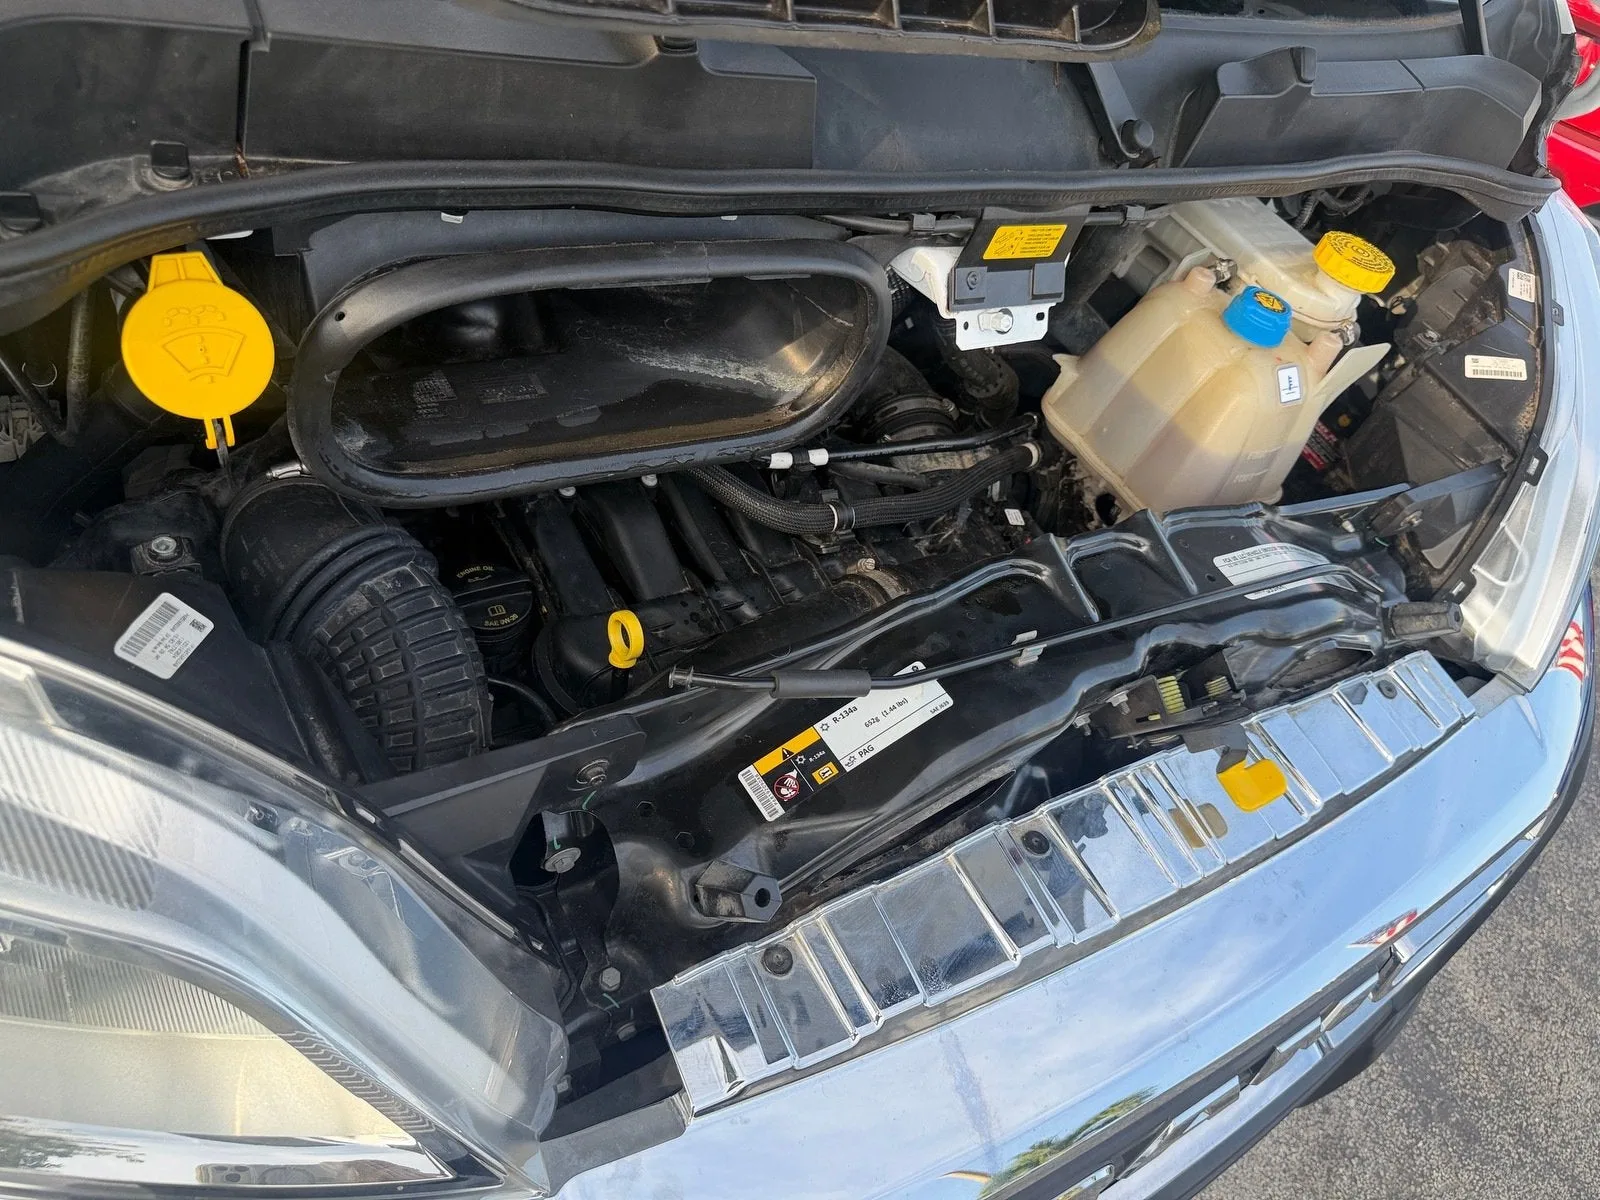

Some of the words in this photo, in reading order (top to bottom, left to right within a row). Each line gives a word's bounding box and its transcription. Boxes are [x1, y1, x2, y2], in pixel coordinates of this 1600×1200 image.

[456, 566, 481, 579] ENGINE
[500, 613, 519, 625] 0W-20
[832, 705, 858, 724] R-134a
[864, 716, 881, 728] 652g
[881, 704, 897, 718] (1.44
[896, 697, 909, 708] lbs)
[808, 750, 826, 762] R-134a
[858, 744, 875, 758] PAG
